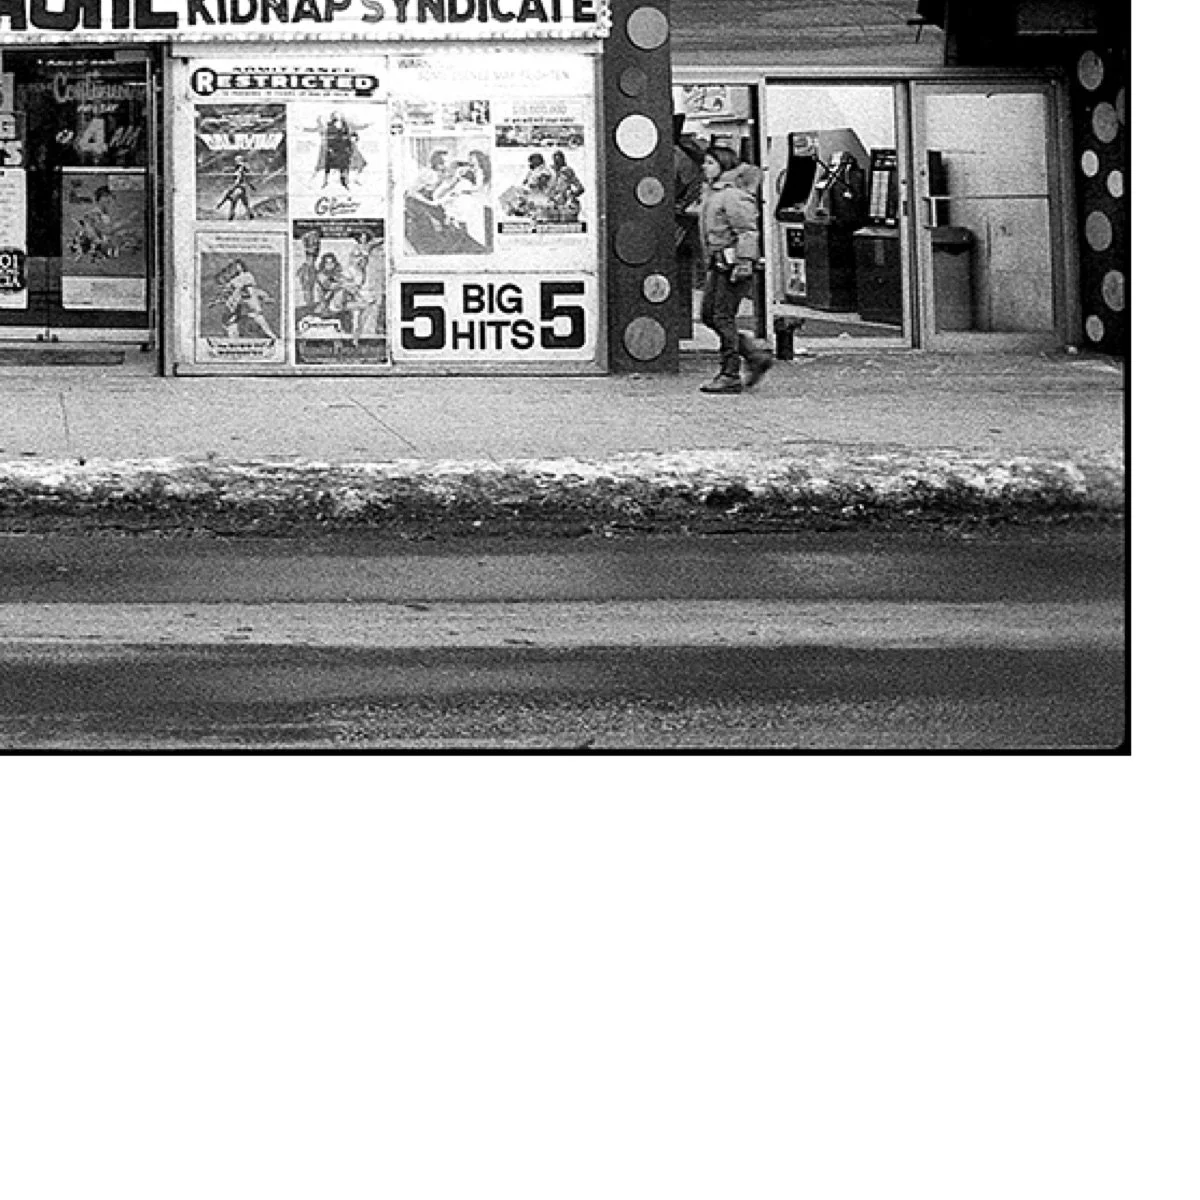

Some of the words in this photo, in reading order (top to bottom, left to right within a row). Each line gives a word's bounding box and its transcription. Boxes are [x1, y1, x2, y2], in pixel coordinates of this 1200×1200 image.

[191, 67, 380, 97] RESTRICTED
[401, 281, 446, 350] 5
[462, 283, 523, 314] BIG
[540, 281, 585, 349] 5
[452, 319, 535, 350] HITS
